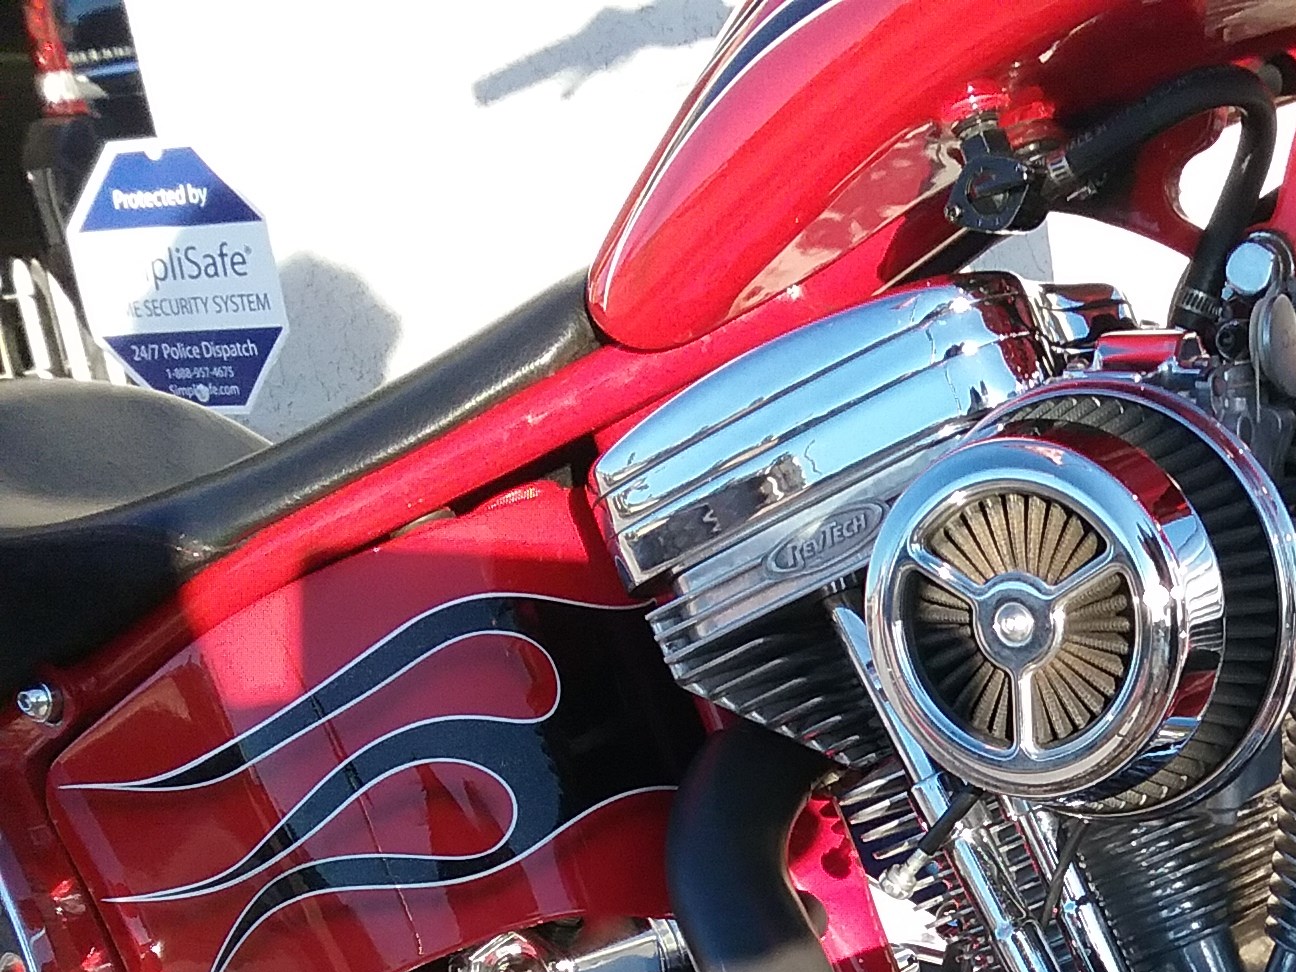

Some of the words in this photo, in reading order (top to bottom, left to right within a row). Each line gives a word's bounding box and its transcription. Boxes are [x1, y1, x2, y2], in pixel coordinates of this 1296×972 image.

[112, 183, 186, 210] Protected
[187, 183, 208, 208] by
[146, 241, 248, 291] pliSafe
[143, 296, 209, 318] SECURITY
[212, 293, 272, 314] SYSTEM
[130, 343, 160, 361] 24/7
[161, 342, 201, 360] Police
[201, 338, 259, 361] Dispatch
